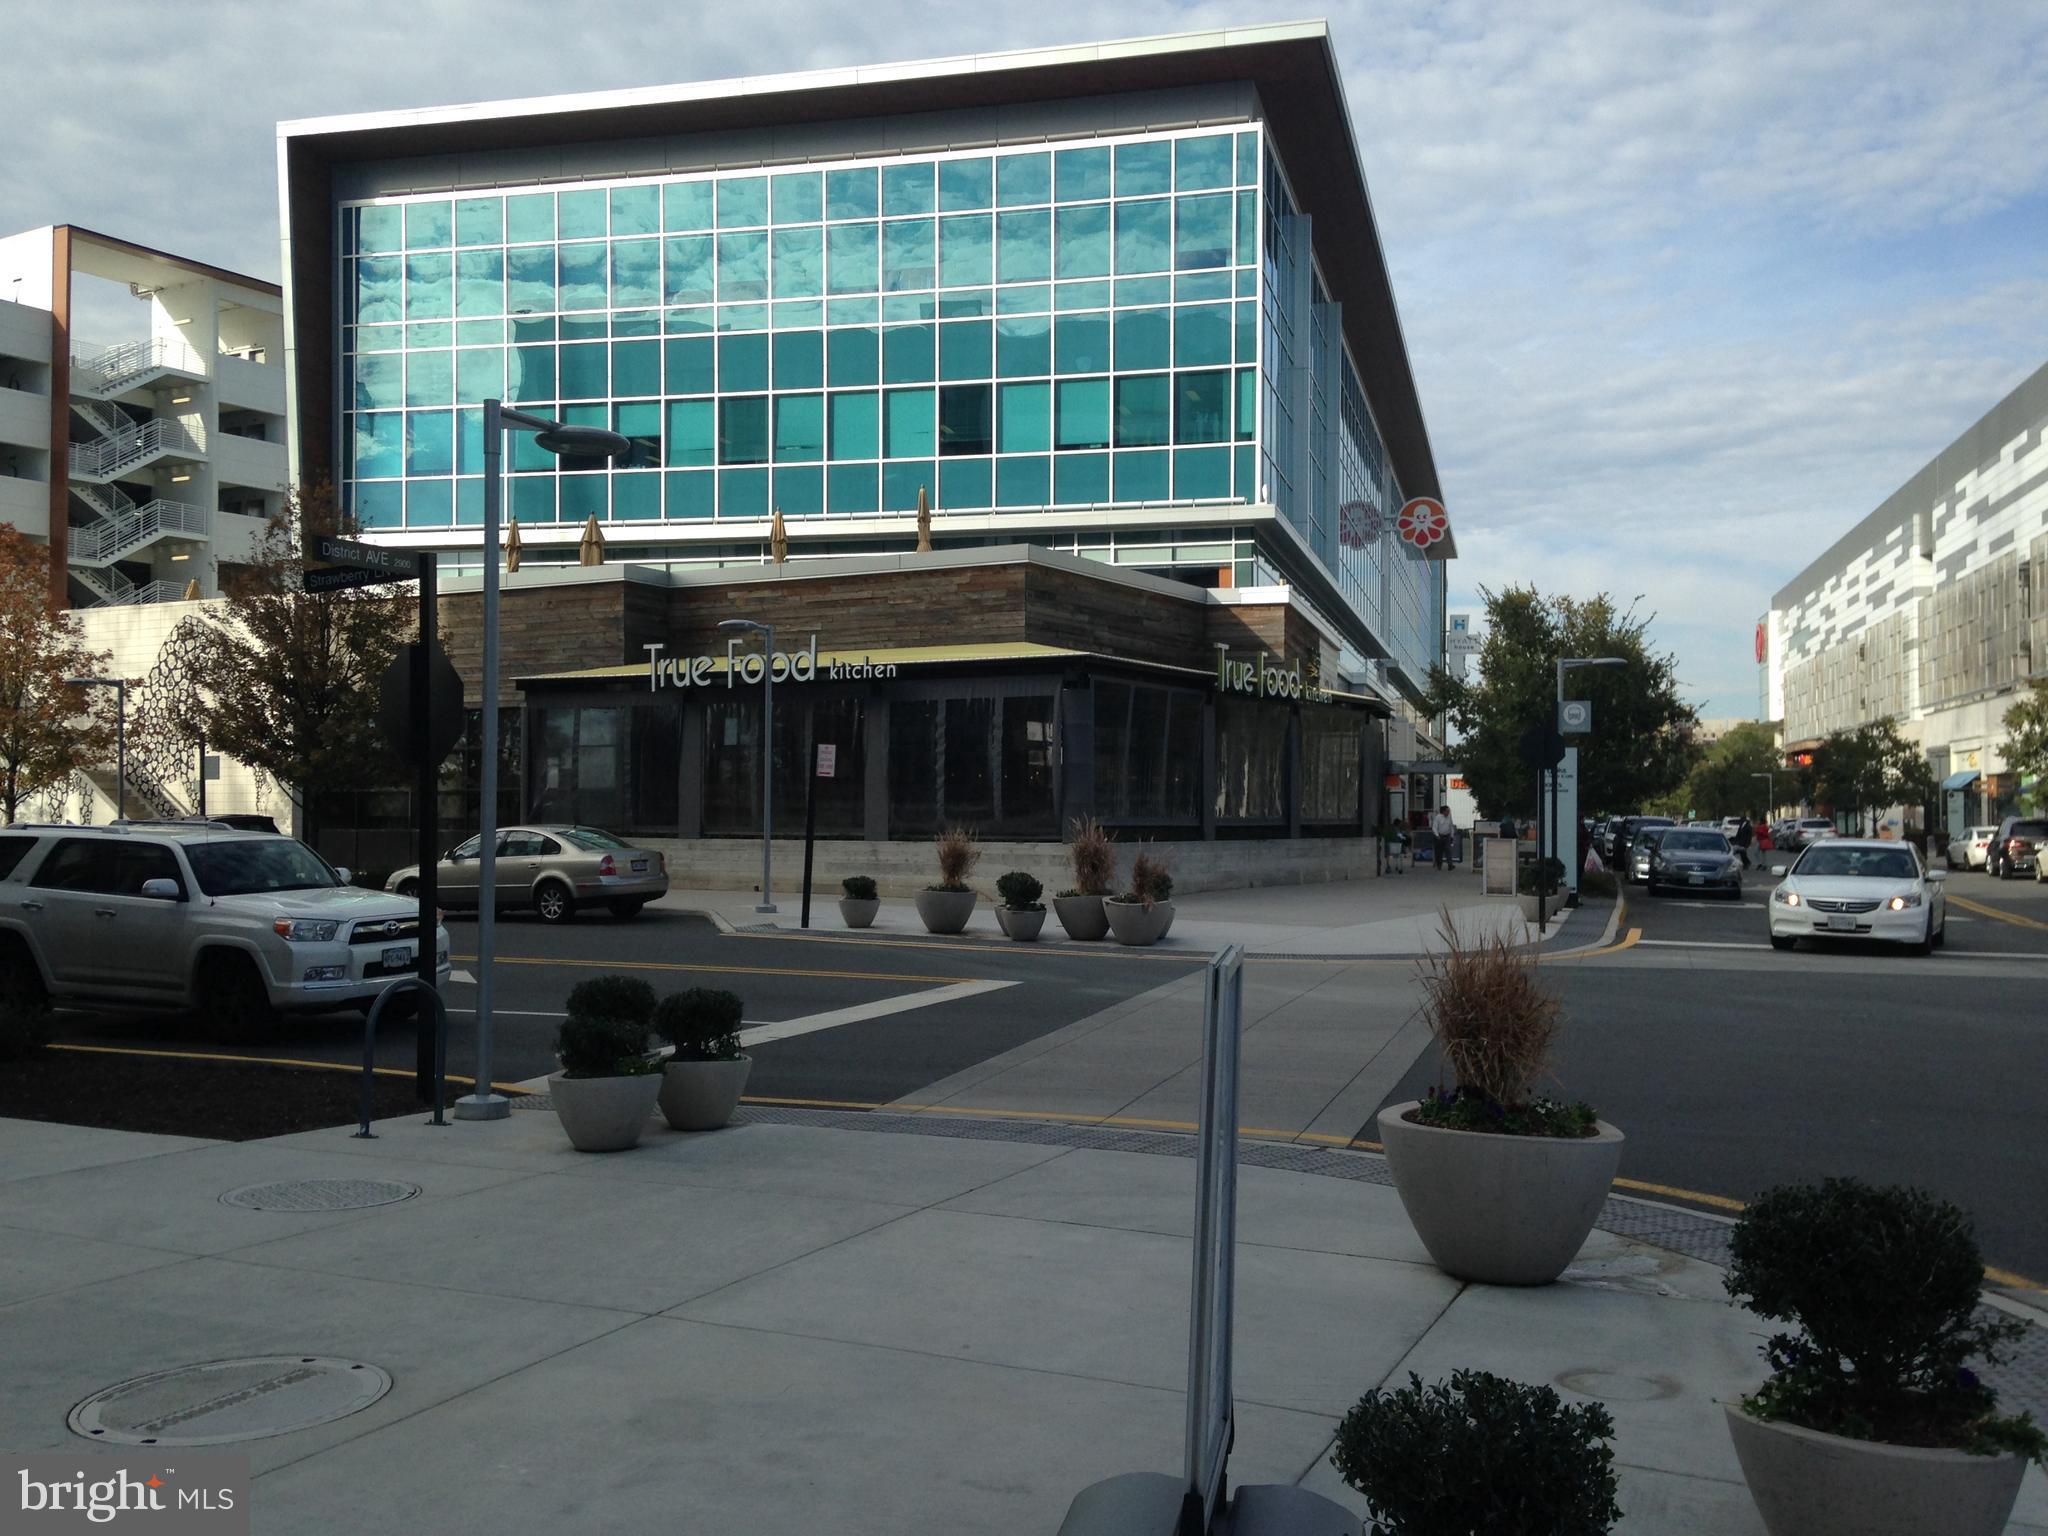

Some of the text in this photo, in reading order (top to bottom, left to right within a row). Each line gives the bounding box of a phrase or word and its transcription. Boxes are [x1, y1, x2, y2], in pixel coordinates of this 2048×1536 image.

[322, 542, 360, 561] District
[365, 549, 390, 566] AVE
[309, 570, 369, 588] Strawberry
[643, 634, 897, 692] True Food kitchen
[1213, 642, 1254, 692] True
[1260, 651, 1300, 700] Food
